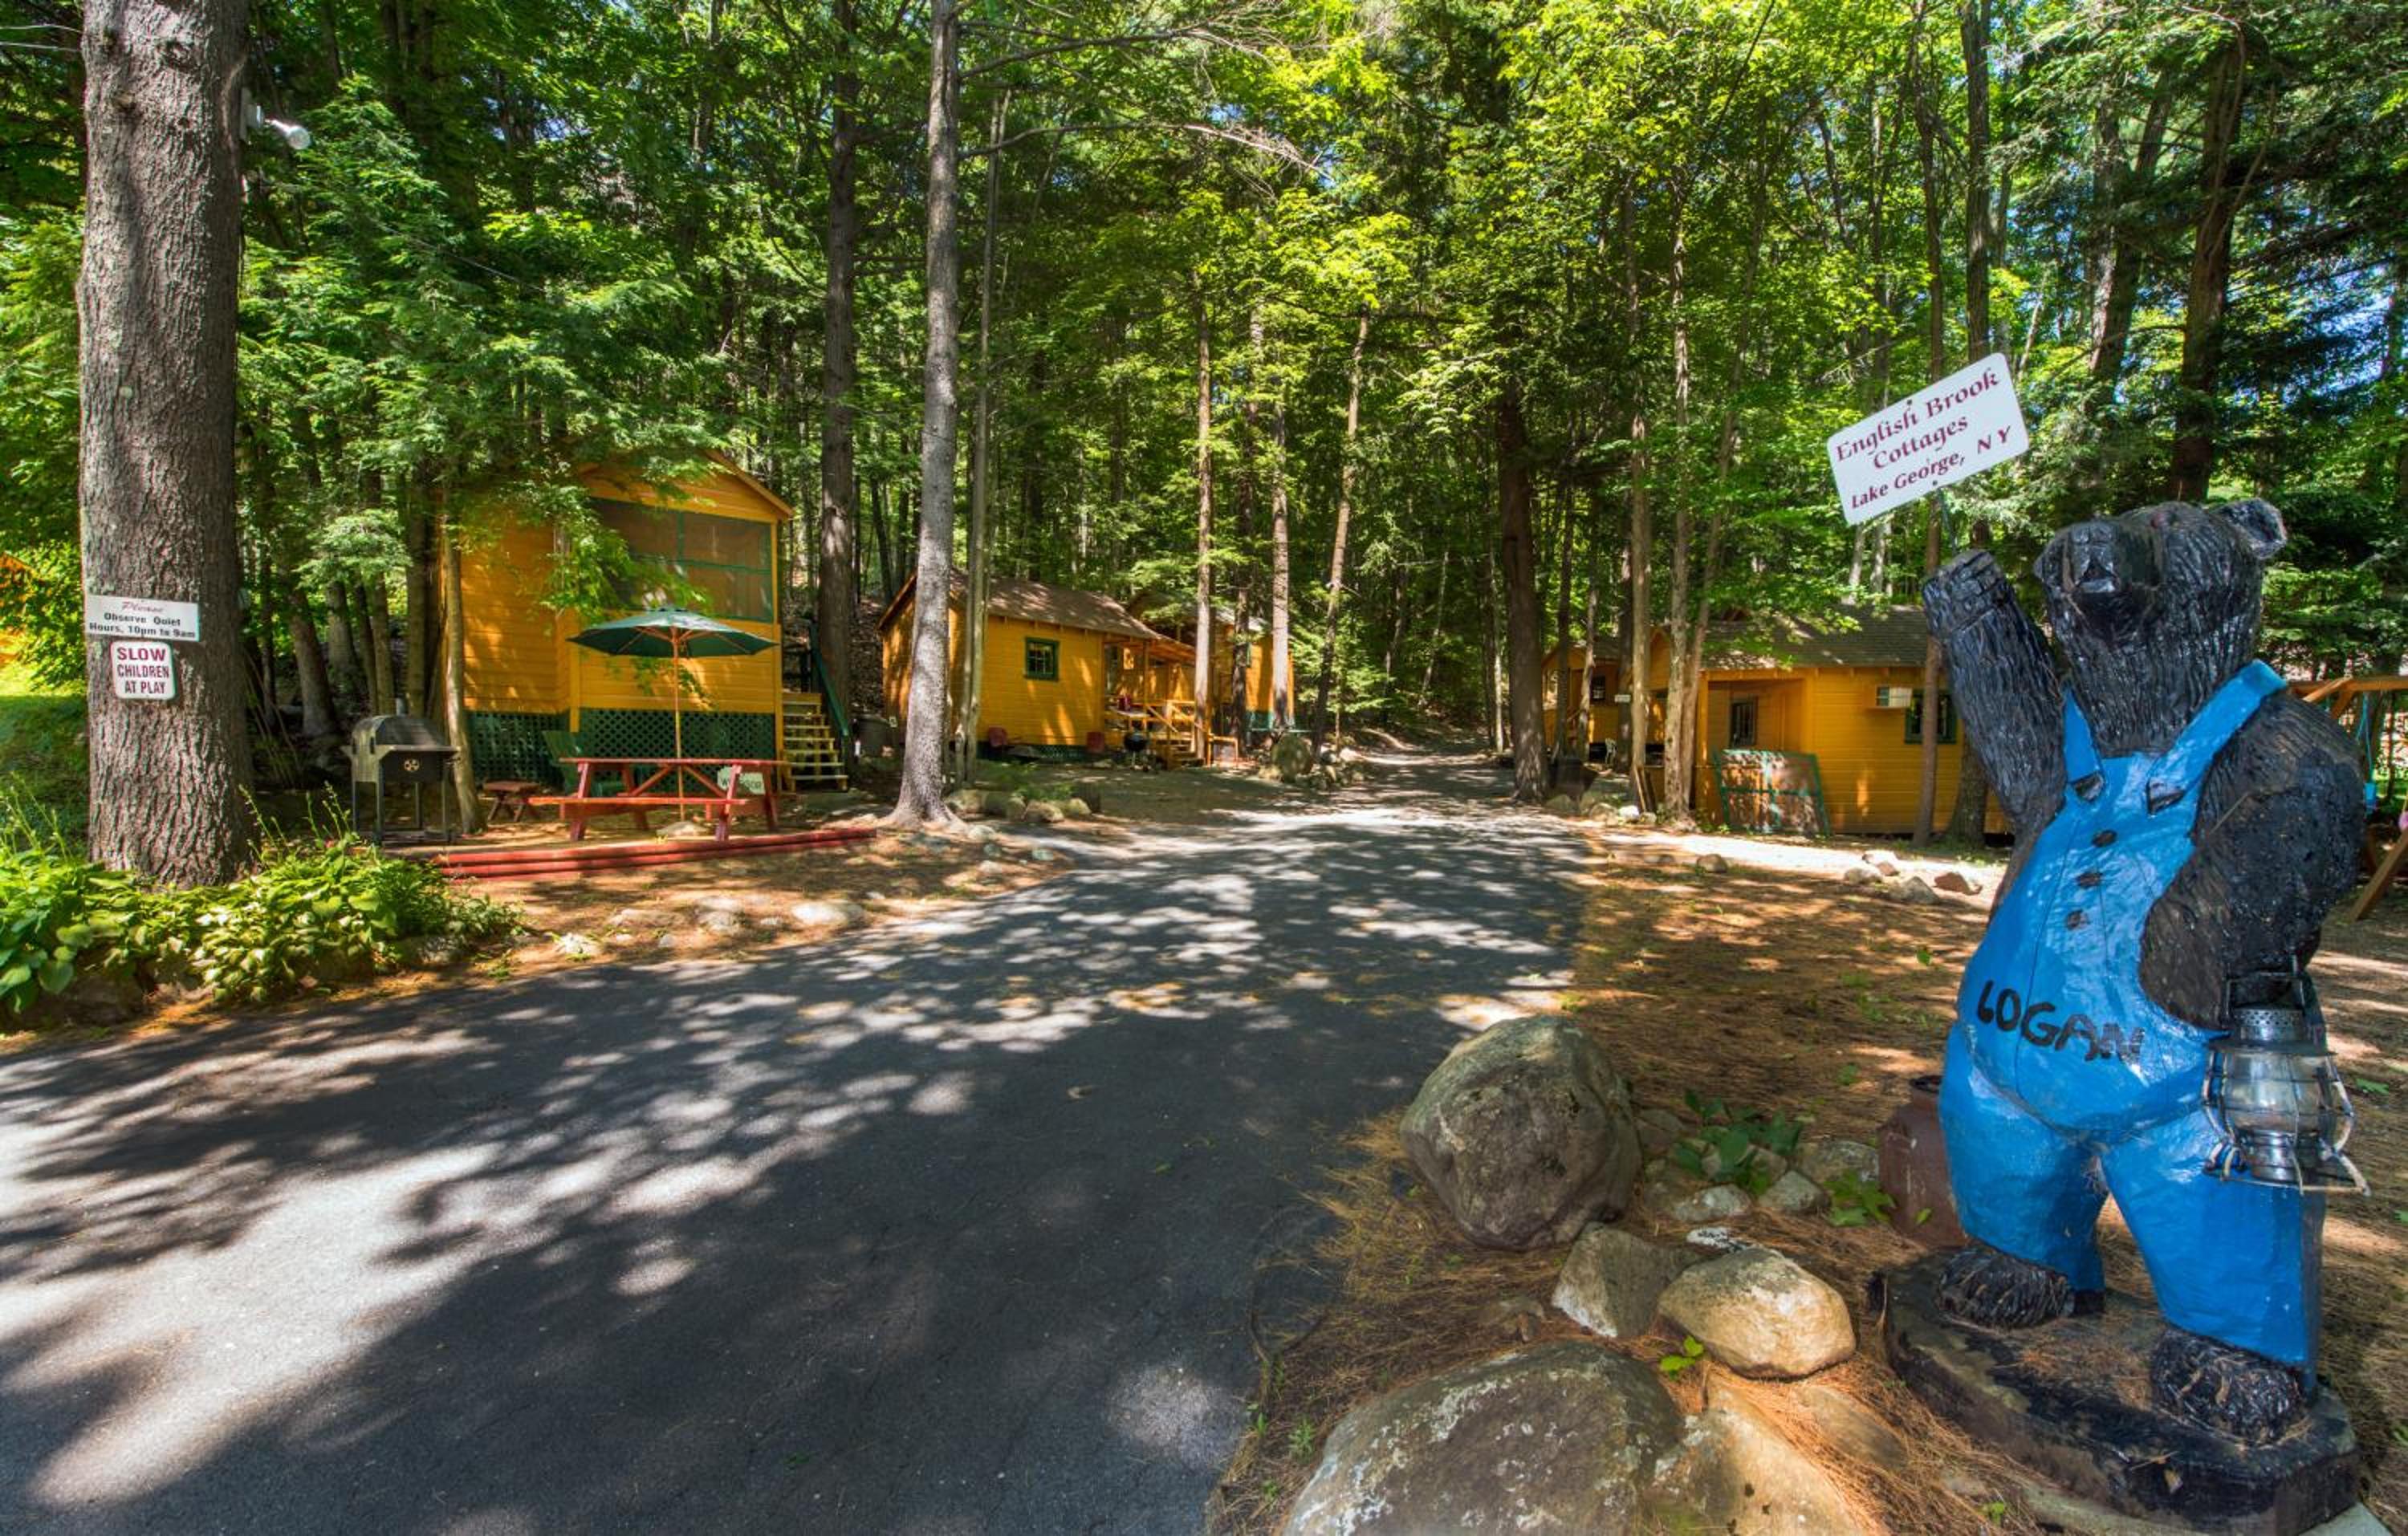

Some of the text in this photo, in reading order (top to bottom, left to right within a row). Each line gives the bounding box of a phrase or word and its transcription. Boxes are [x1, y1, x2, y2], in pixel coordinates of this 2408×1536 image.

[1836, 367, 2000, 462] English Brook
[1873, 415, 1969, 469] Cottages
[1851, 482, 1889, 509] Lake
[1893, 452, 1966, 489] George,
[104, 612, 181, 627] Observe Quiet
[128, 624, 157, 637] 10pm
[160, 628, 170, 636] to
[173, 628, 196, 638] 9am
[116, 647, 166, 662] SLOW
[116, 664, 169, 679] CHILDREN
[124, 681, 165, 694] AT PLAY
[1977, 979, 2146, 1063] LOGAN
